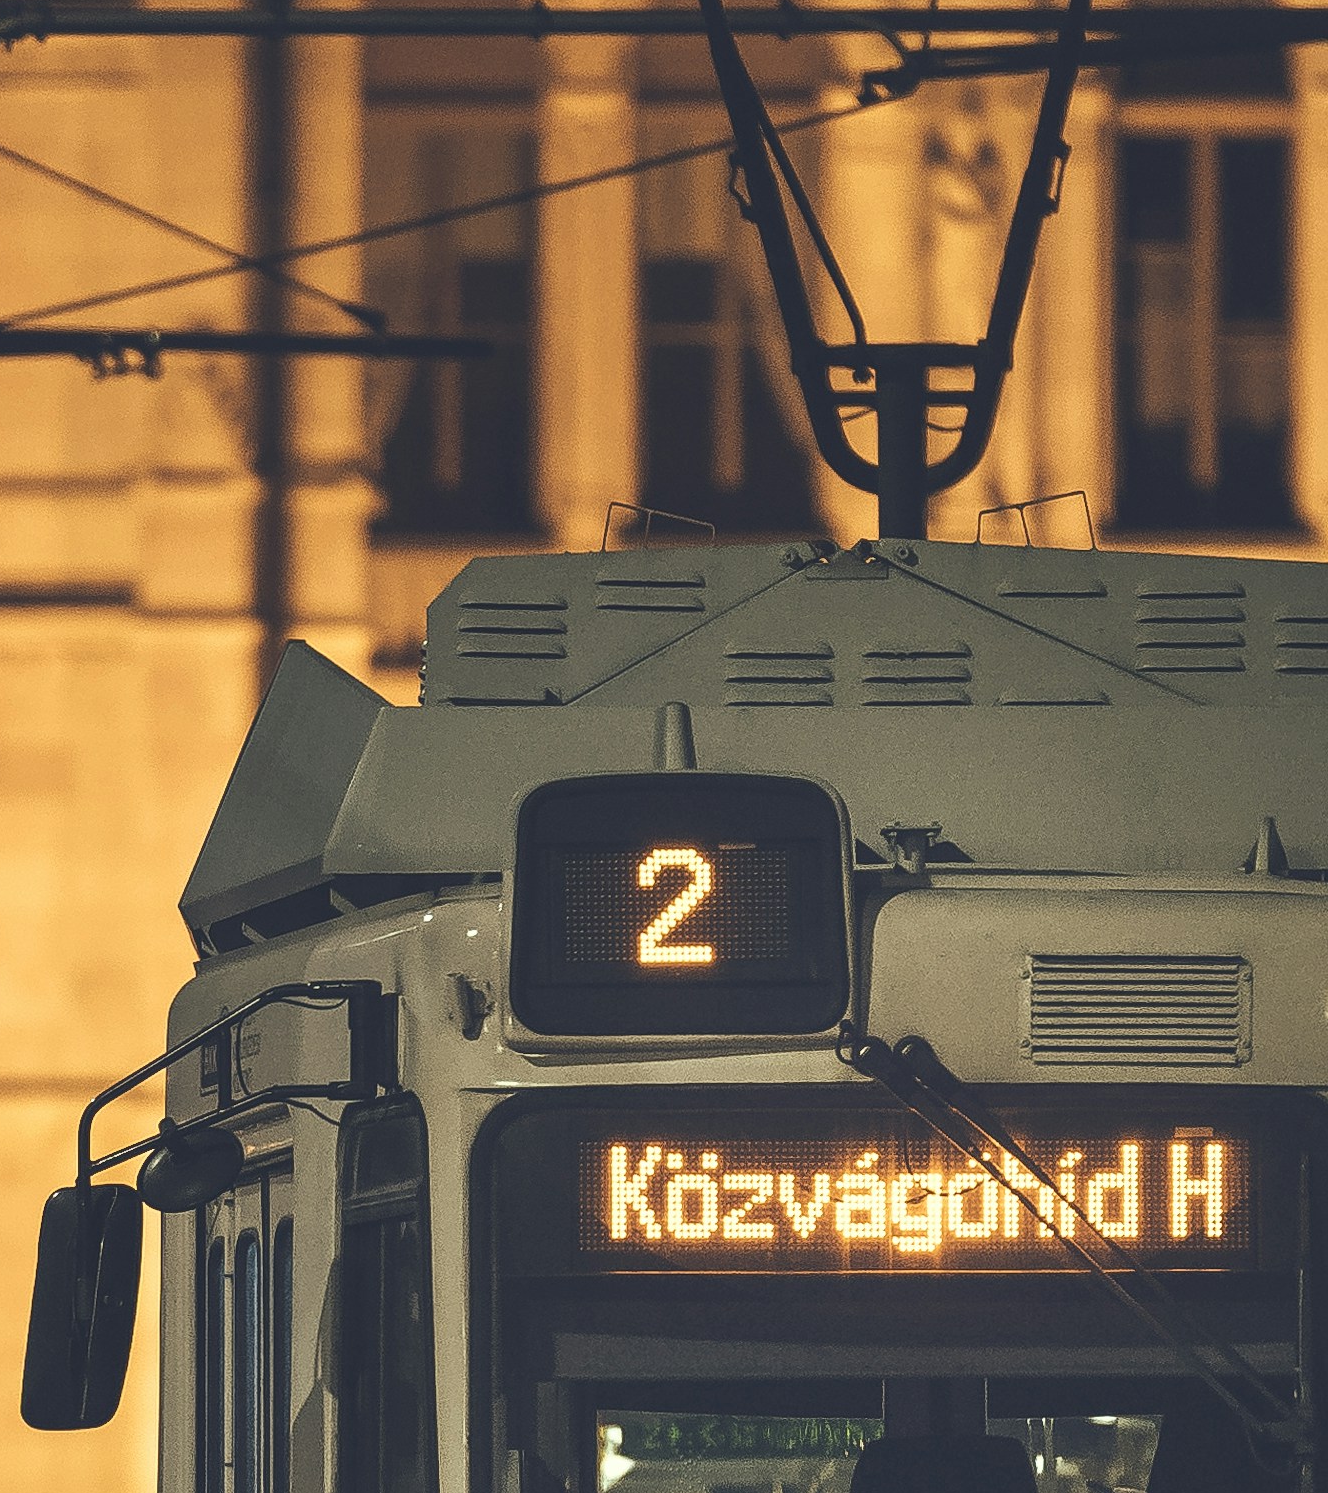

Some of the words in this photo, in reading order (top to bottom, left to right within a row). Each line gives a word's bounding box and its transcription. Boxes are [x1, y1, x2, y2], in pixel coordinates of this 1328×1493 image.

[636, 847, 715, 966] 2
[608, 1144, 1139, 1253] Közvágóhíd
[1170, 1143, 1224, 1239] H
